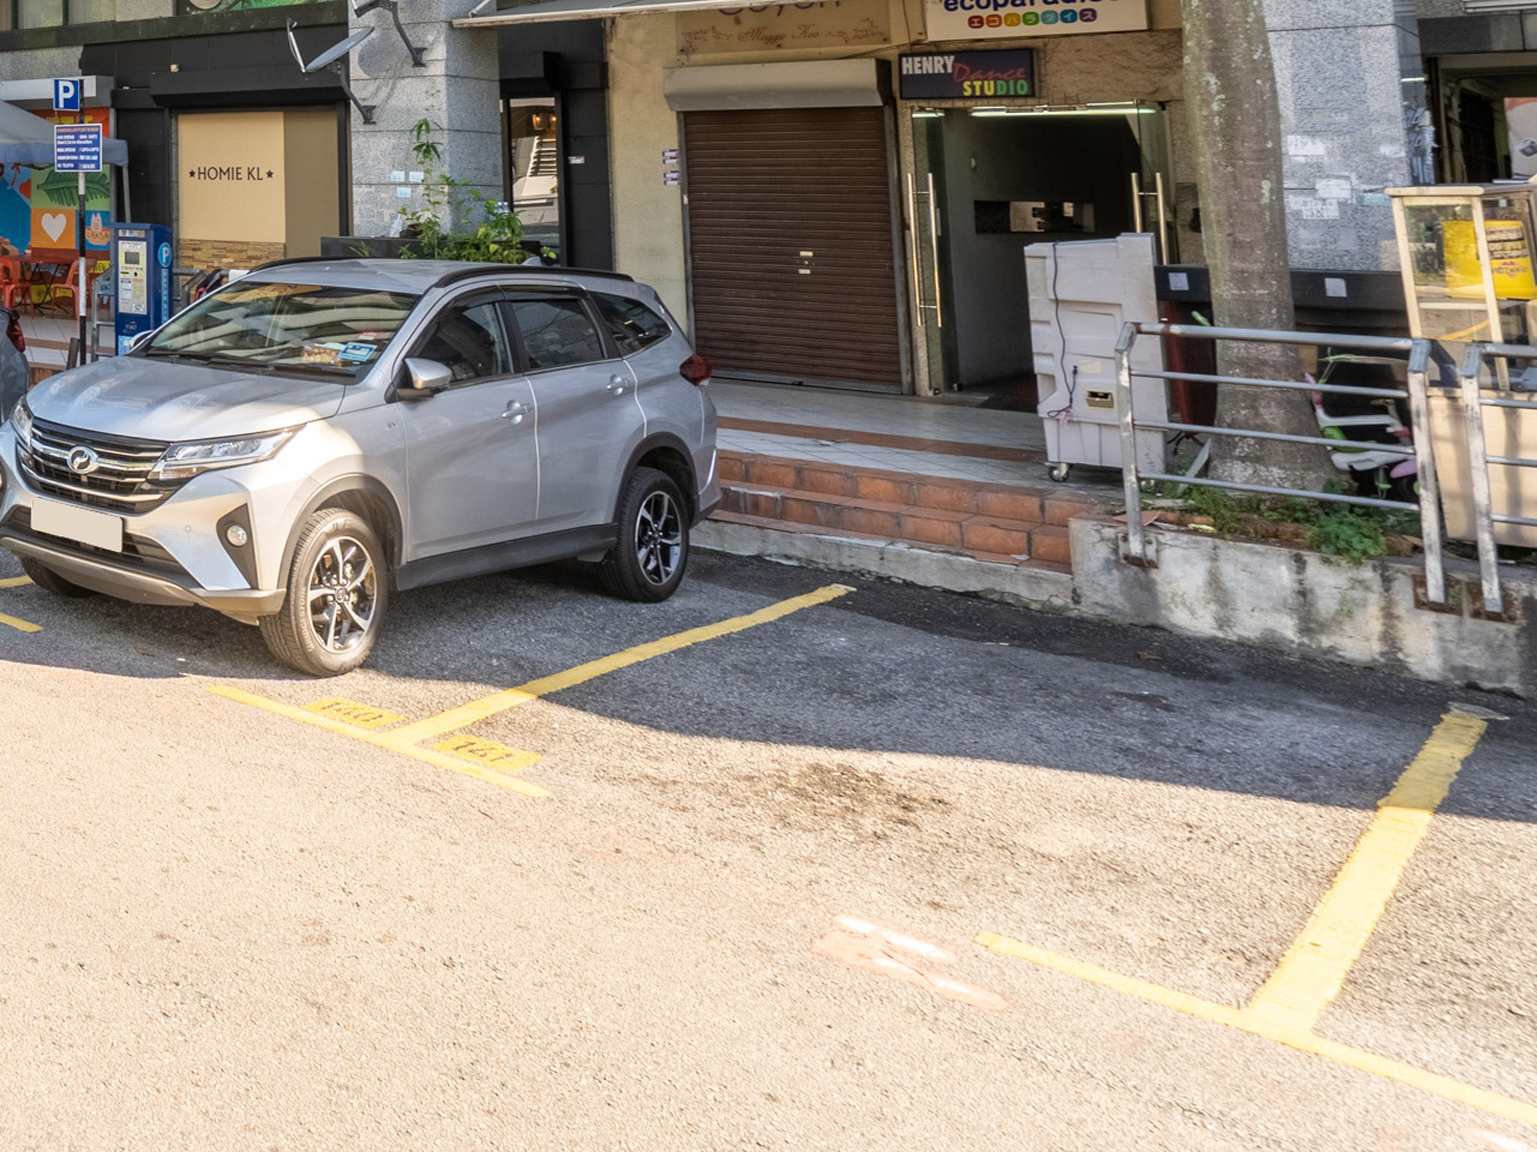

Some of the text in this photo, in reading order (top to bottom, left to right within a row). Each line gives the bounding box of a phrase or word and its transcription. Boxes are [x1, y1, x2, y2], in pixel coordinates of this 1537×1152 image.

[901, 55, 955, 75] HENRY
[952, 61, 1027, 82] Dance
[58, 79, 76, 109] P
[963, 79, 1029, 96] STUDIO
[197, 166, 264, 181] HOMIE KL
[161, 246, 171, 263] P
